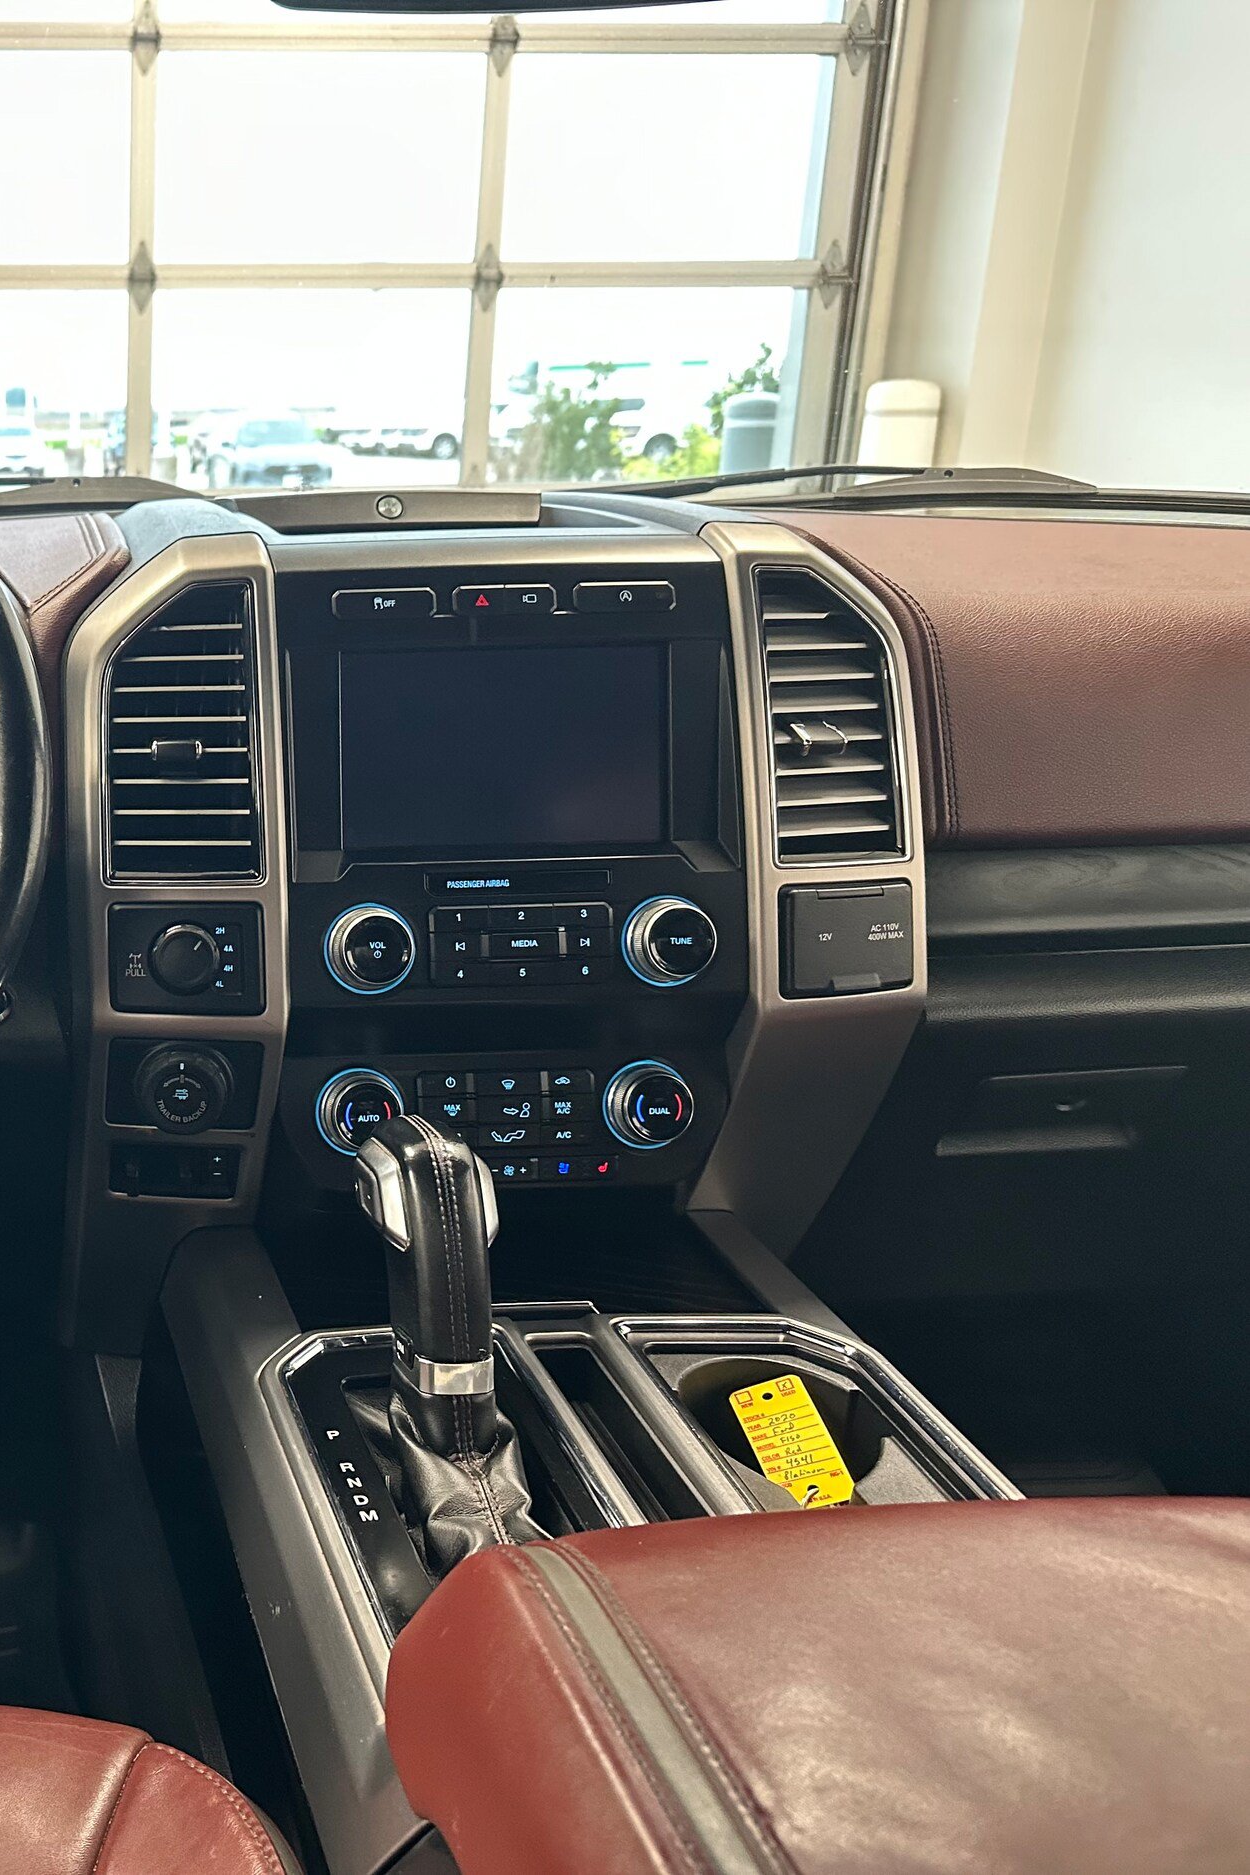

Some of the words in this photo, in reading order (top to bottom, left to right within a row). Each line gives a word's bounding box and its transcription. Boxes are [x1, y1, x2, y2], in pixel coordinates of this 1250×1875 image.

[383, 599, 396, 608] OFF
[446, 880, 485, 889] PASSENGER
[485, 879, 510, 888] AIRBAG
[456, 913, 462, 922] 1
[517, 911, 525, 920] 2
[580, 909, 587, 918] 3
[215, 927, 225, 935] 2H
[870, 924, 881, 933] AC
[882, 922, 900, 931] 110V
[818, 933, 833, 941] 12V
[867, 932, 887, 941] 400W
[887, 930, 904, 939] MAX
[369, 941, 387, 950] VOL
[511, 939, 538, 949] MEDIA
[669, 936, 693, 946] TUNE
[223, 944, 234, 953] 4A
[125, 968, 146, 977] PULL
[223, 964, 234, 973] 4H
[519, 968, 526, 977] 5
[582, 966, 589, 975] 6
[457, 970, 464, 979] 4
[215, 980, 224, 988] 4L
[157, 1099, 181, 1122] TRAILER
[182, 1100, 207, 1123] BACKUP
[556, 1107, 571, 1115] A/C
[648, 1107, 670, 1116] DUAL
[358, 1113, 380, 1123] AUTO
[556, 1131, 572, 1139] A/C
[768, 1413, 796, 1426] 2020
[326, 1430, 340, 1440] P
[785, 1444, 802, 1456] Red
[339, 1462, 355, 1472] R
[346, 1477, 362, 1488] N
[353, 1495, 369, 1506] D
[359, 1510, 379, 1522] M
